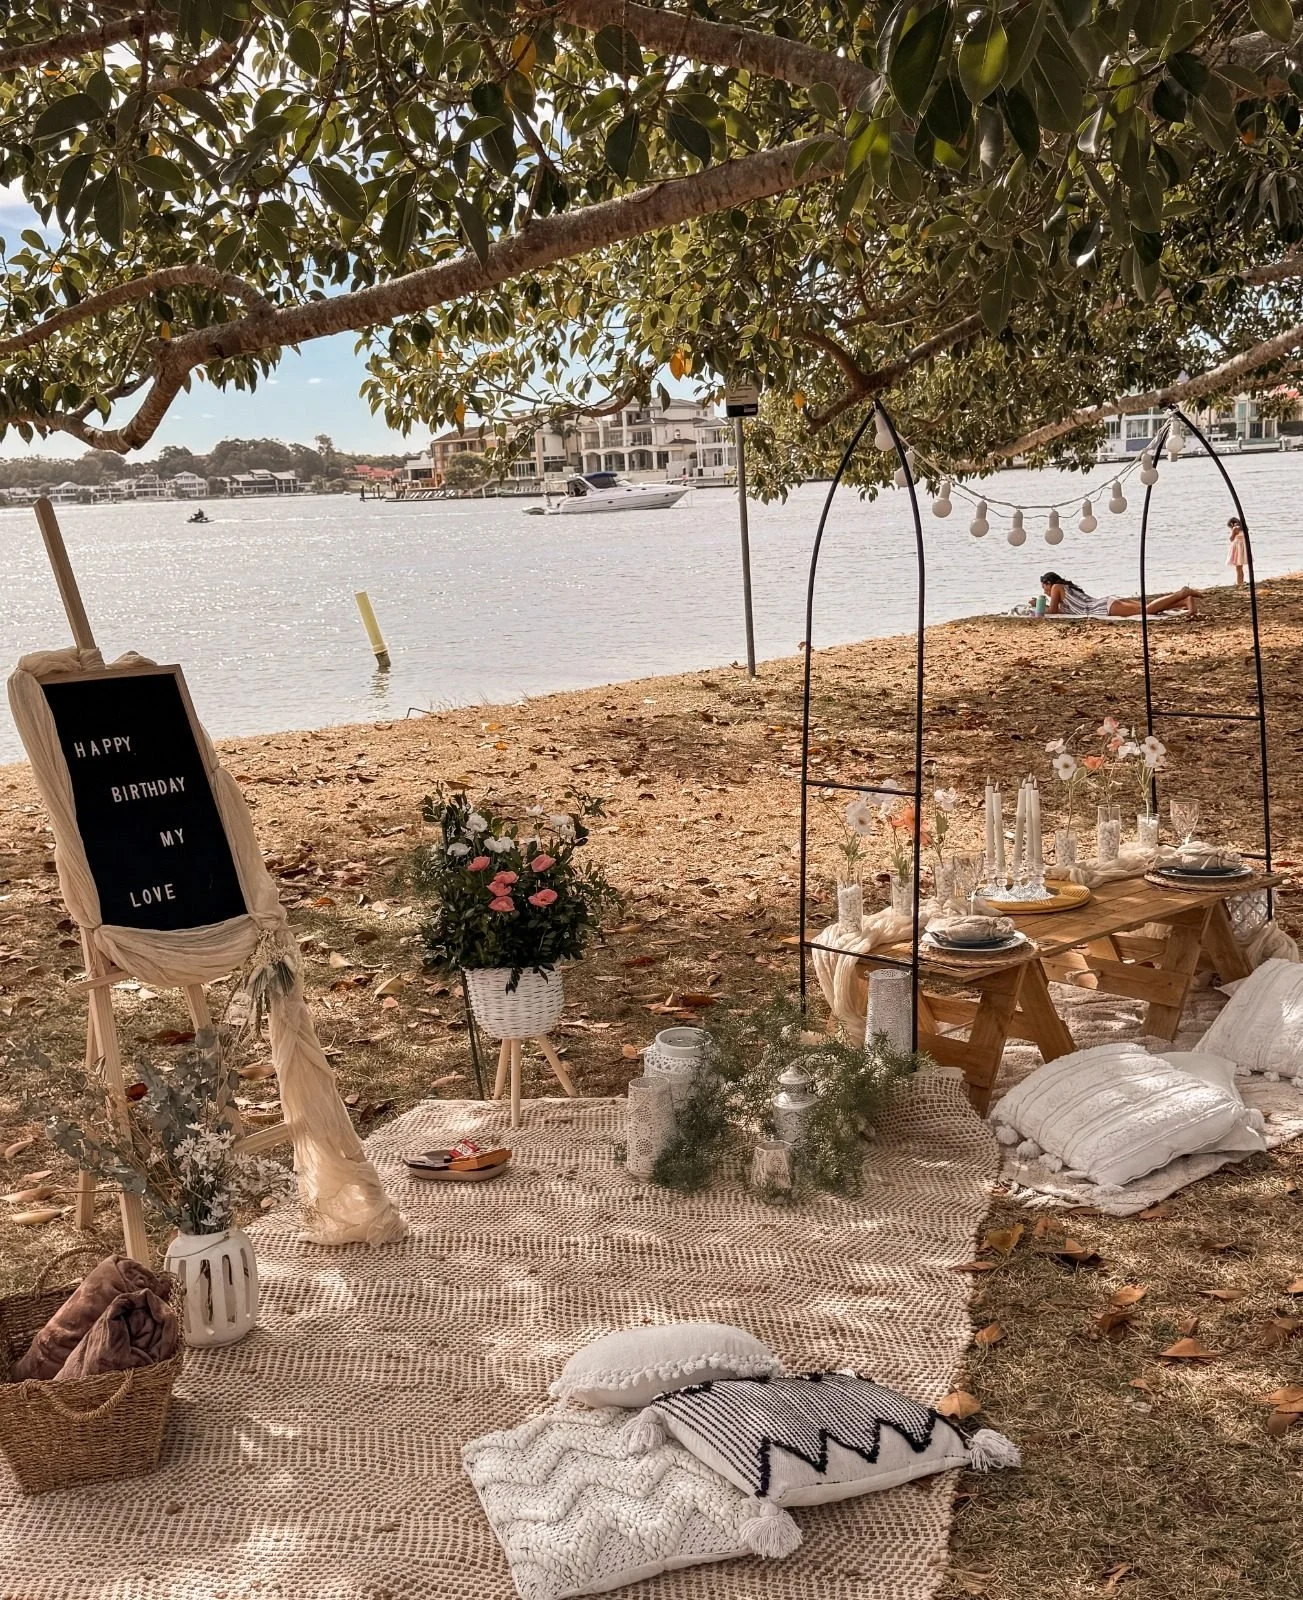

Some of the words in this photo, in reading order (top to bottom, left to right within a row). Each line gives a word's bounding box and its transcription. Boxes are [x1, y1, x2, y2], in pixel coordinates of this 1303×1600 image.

[74, 736, 131, 758] HAPPY
[111, 777, 185, 802] BIRTHDAY
[159, 828, 184, 847] MY
[129, 883, 176, 907] LOVE
